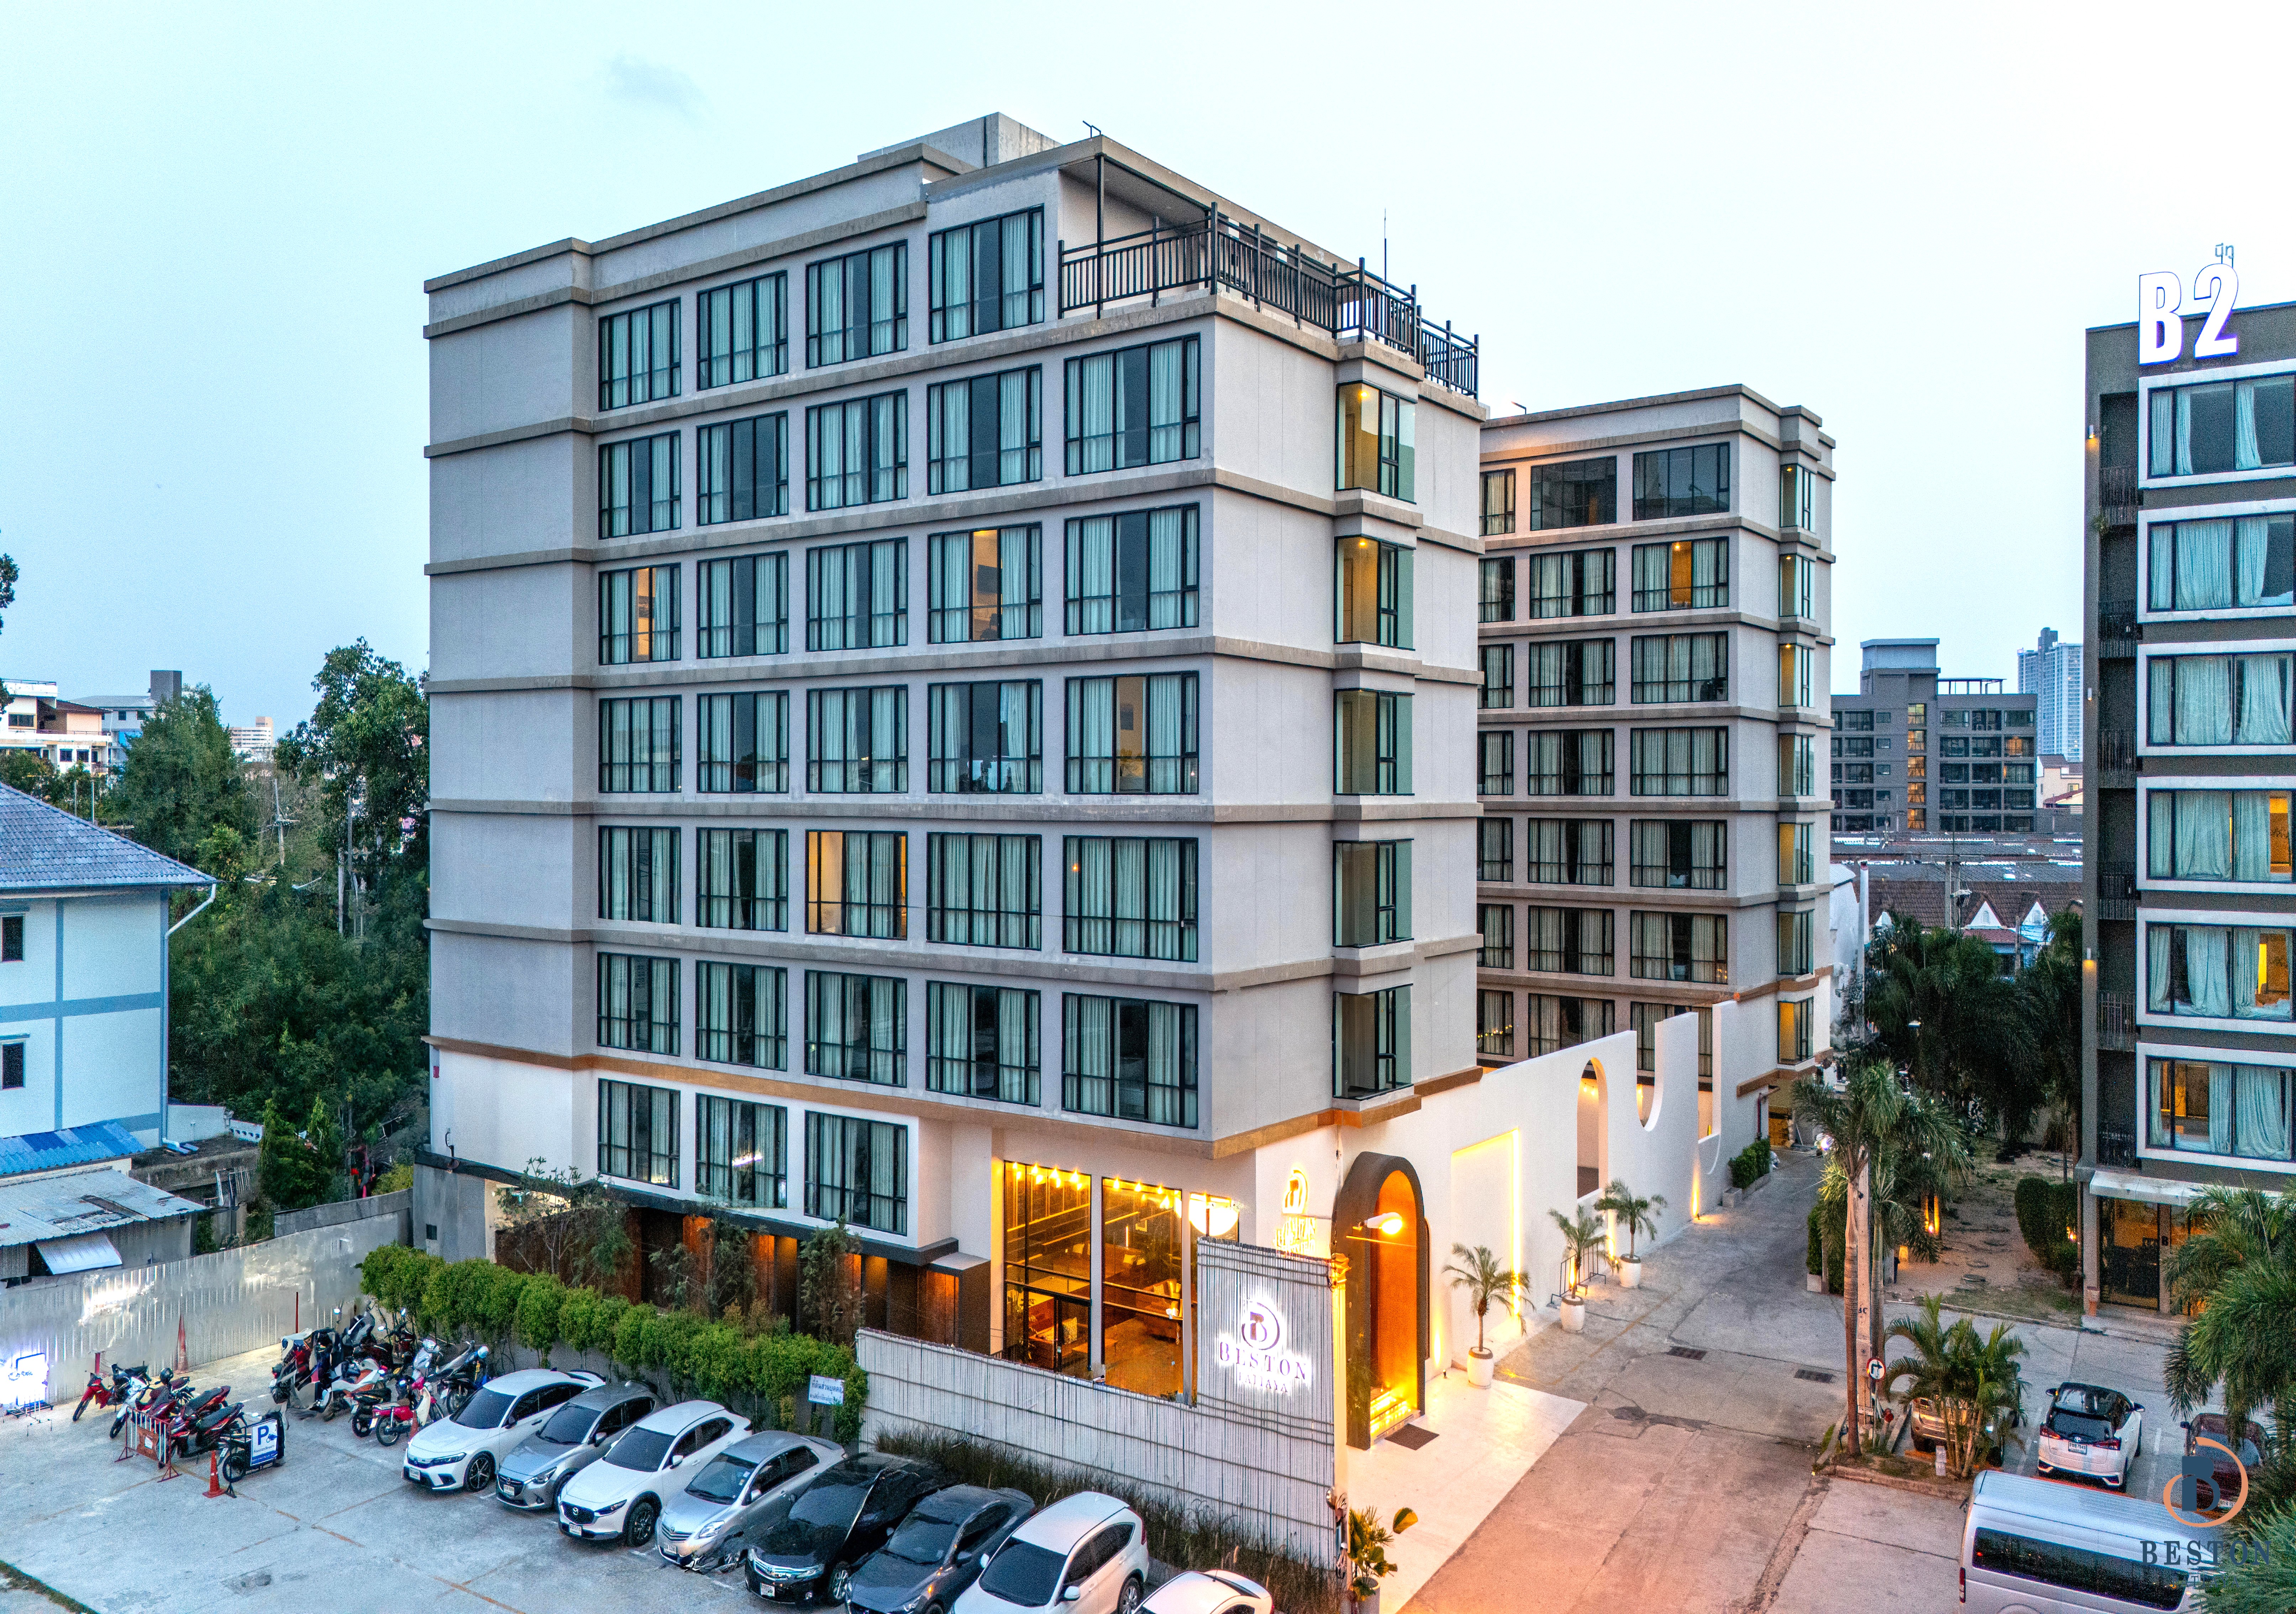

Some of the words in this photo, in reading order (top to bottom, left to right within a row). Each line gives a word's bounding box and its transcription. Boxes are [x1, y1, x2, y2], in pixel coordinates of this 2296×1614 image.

[2138, 263, 2239, 365] B2
[1220, 1341, 1306, 1380] BESTON
[258, 1425, 269, 1445] P
